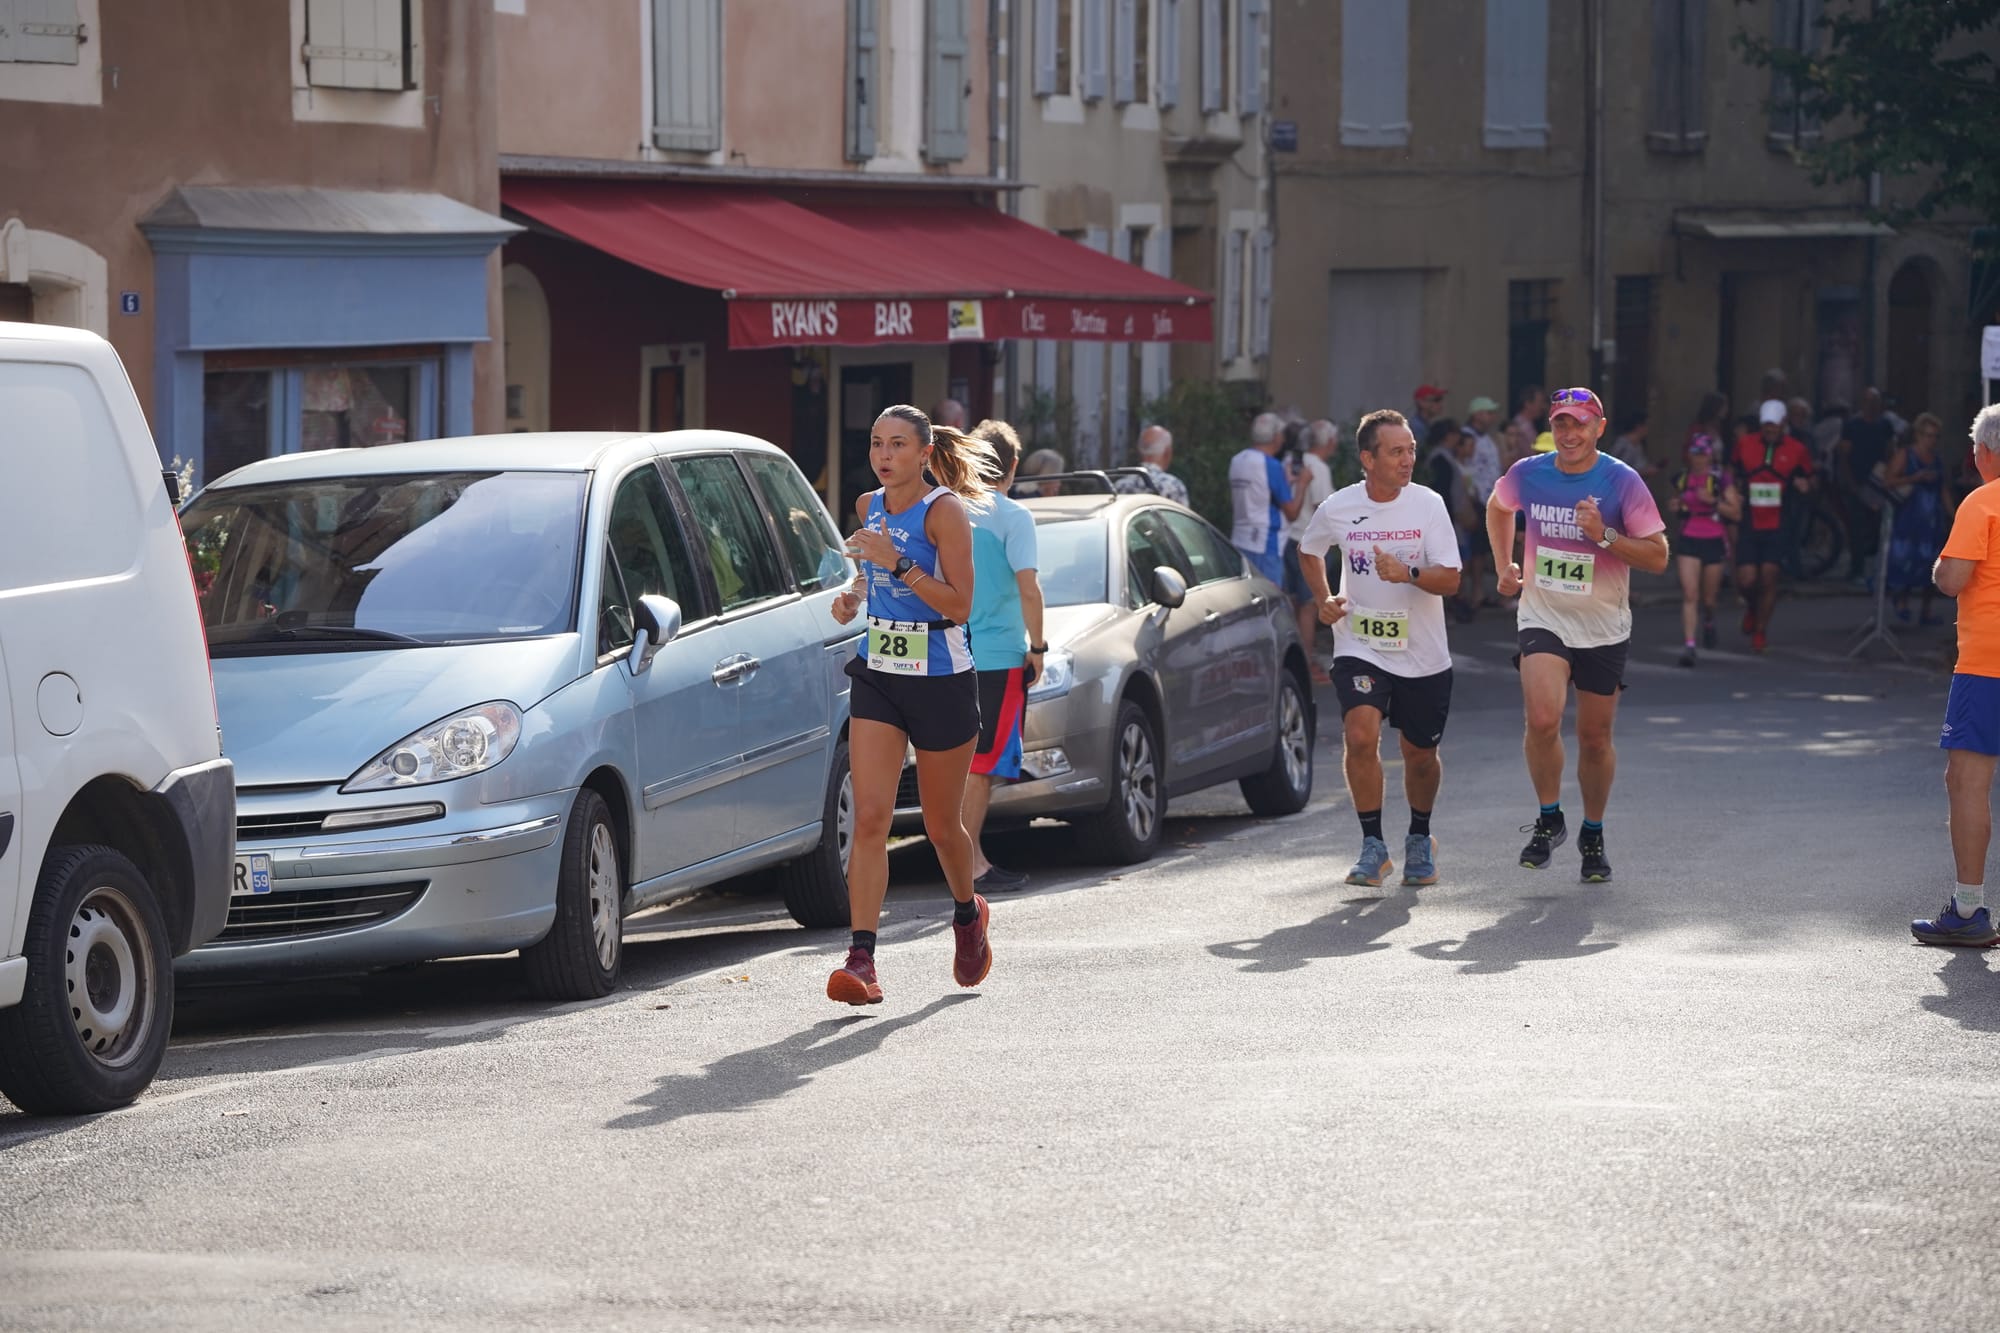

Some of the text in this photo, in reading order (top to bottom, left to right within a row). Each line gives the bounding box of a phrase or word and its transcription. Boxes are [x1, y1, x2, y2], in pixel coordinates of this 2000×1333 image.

[127, 295, 135, 311] 6
[772, 301, 838, 337] RYAN'S
[874, 302, 913, 336] BAR
[1022, 303, 1046, 333] Chez
[1346, 529, 1422, 541] MENDEKIDEN
[1541, 521, 1584, 541] MENDE
[1543, 559, 1585, 581] 114
[1359, 618, 1400, 638] 183
[880, 634, 908, 657] 28
[233, 862, 248, 890] R
[253, 874, 269, 888] 59
